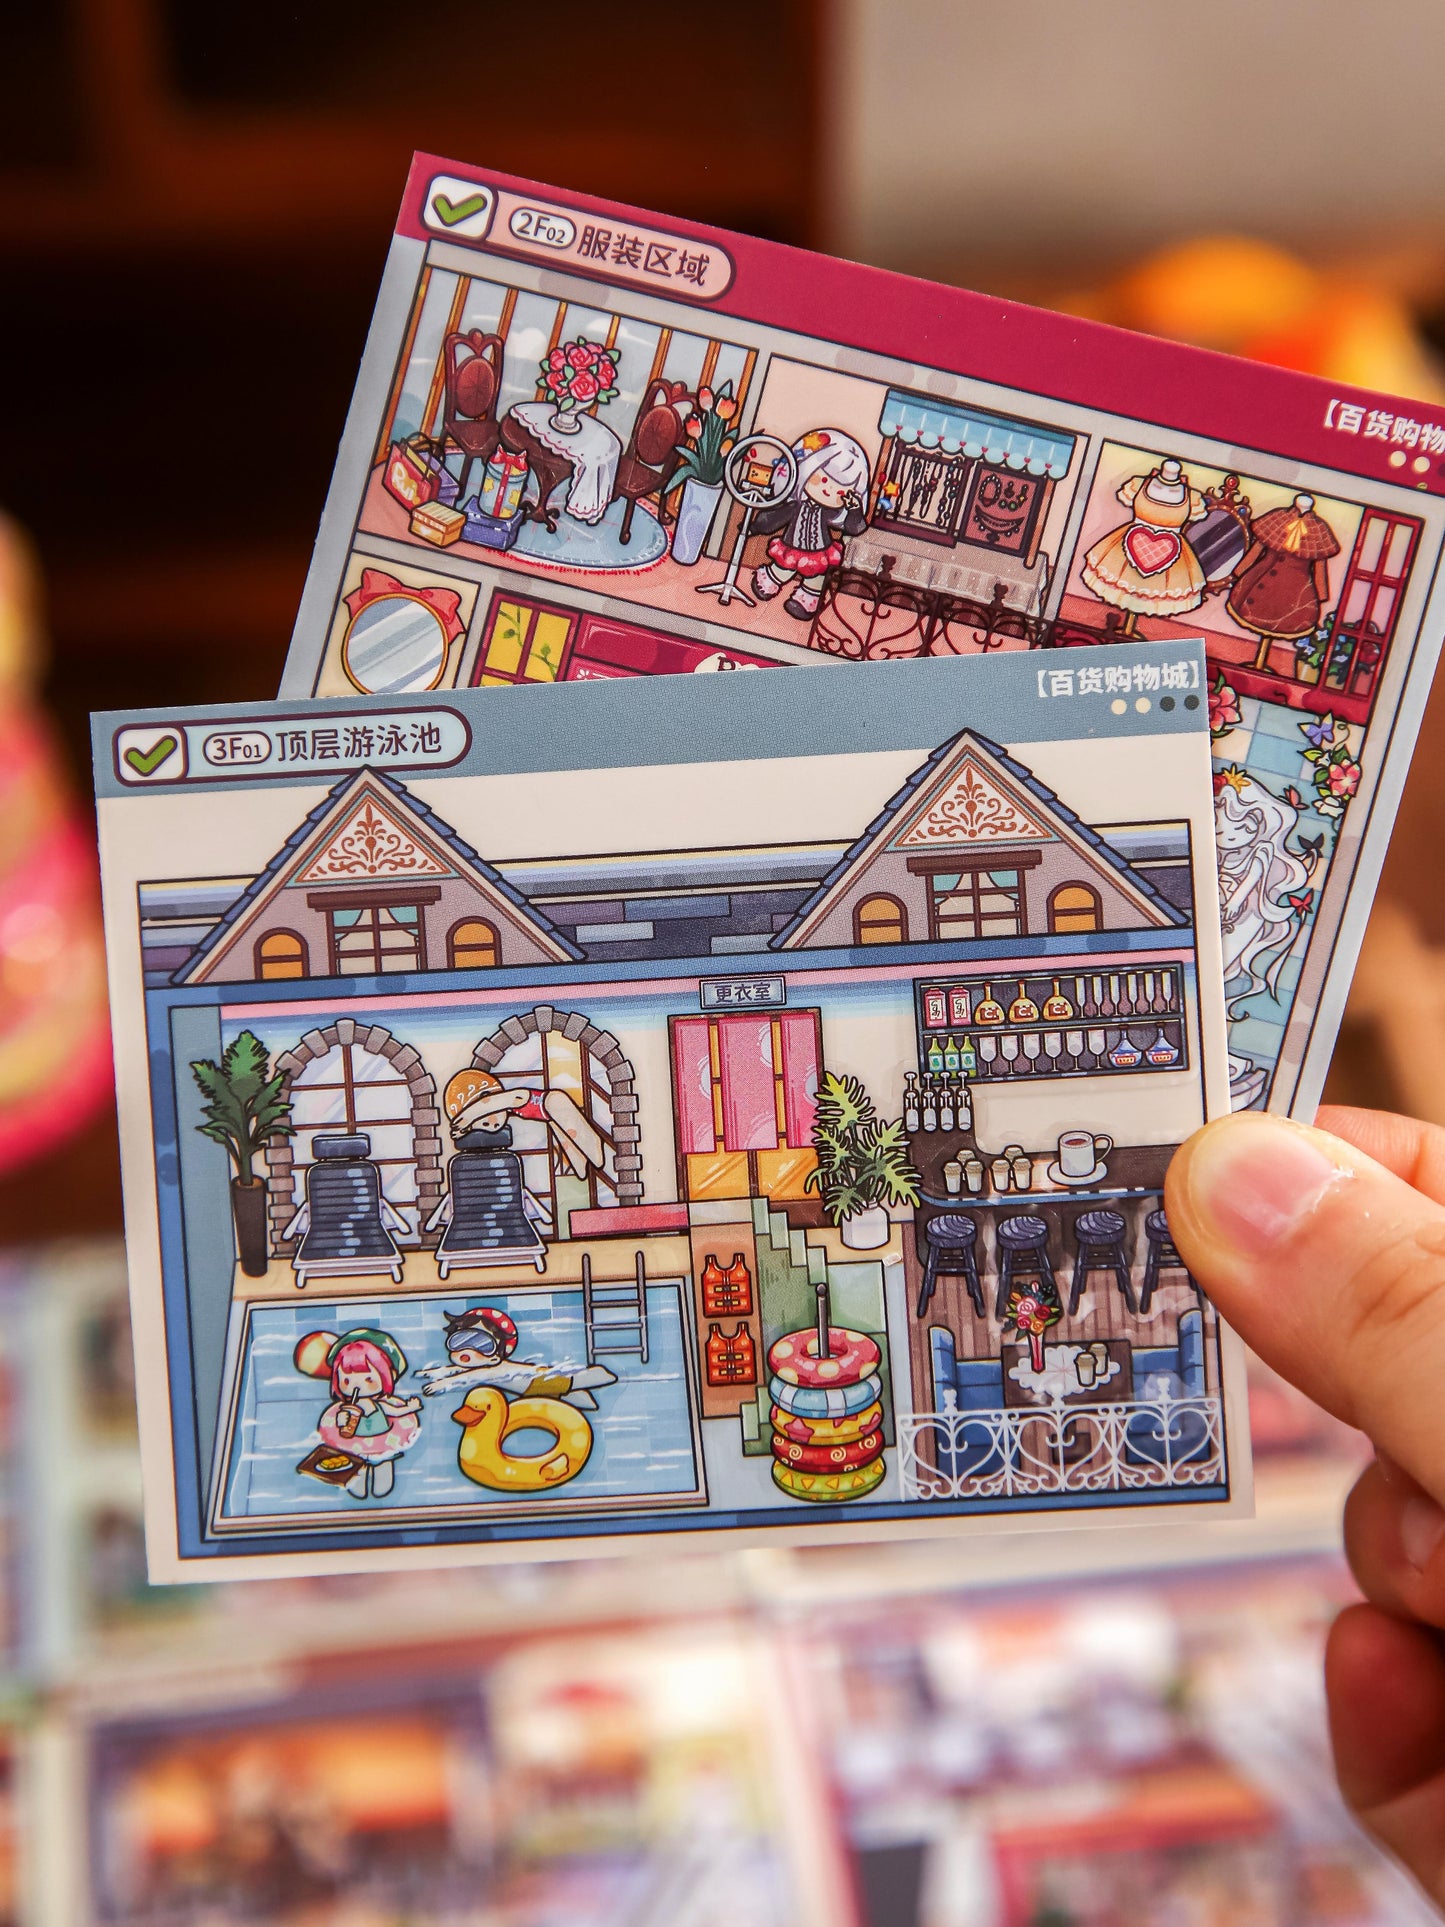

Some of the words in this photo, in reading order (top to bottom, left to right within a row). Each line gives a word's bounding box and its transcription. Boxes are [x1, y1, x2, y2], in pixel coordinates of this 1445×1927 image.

[516, 212, 566, 244] 2F02
[576, 224, 711, 286] 服装区域
[1037, 660, 1200, 698] 【百货购物城】
[212, 737, 262, 761] 3F01
[275, 722, 442, 762] 顶层游泳池
[714, 982, 772, 1004] 更衣室
